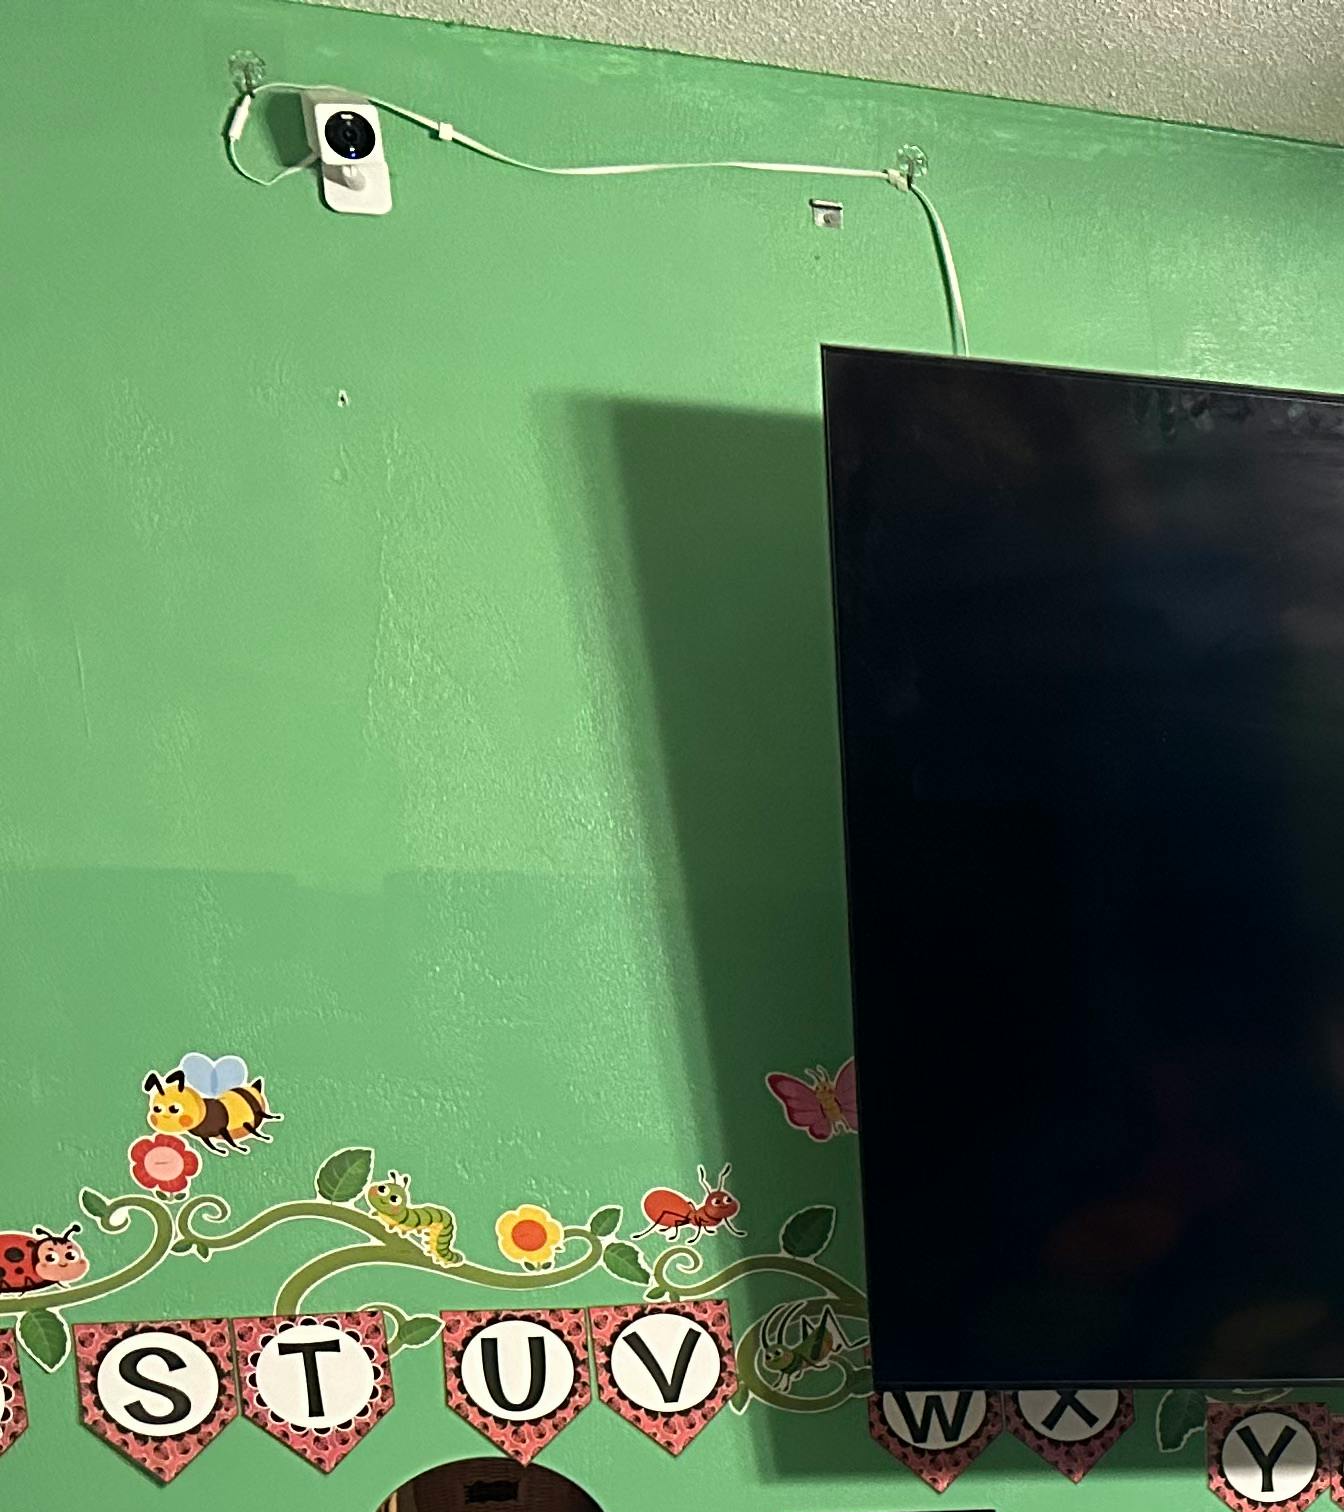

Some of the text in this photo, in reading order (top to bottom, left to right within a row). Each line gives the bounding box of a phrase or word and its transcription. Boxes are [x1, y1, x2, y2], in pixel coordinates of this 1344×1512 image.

[117, 1347, 191, 1426] S
[278, 1340, 342, 1418] T
[481, 1336, 546, 1412] U
[623, 1328, 702, 1404] V
[889, 1390, 974, 1443] W
[1235, 1425, 1297, 1493] Y
